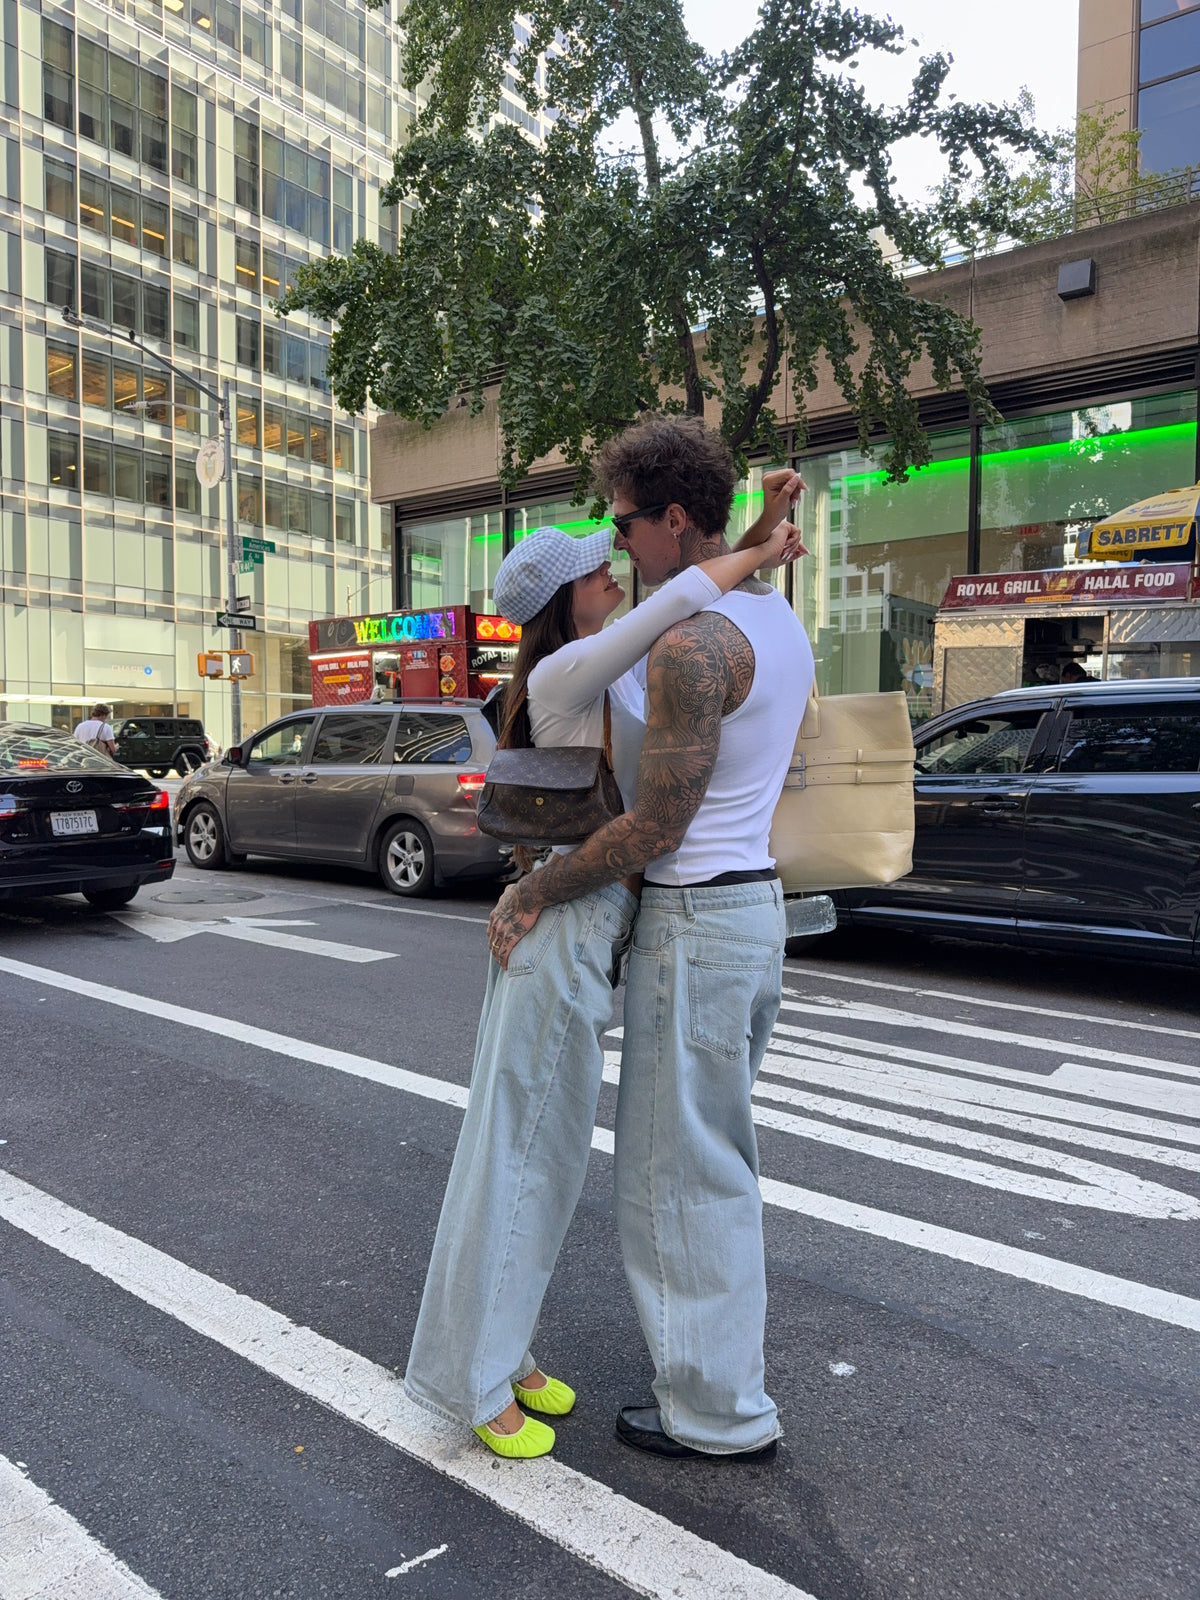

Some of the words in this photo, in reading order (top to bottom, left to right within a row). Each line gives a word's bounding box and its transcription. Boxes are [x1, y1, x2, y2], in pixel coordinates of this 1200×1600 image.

[1097, 523, 1189, 546] SABRETT
[956, 582, 1000, 597] ROYAL
[1003, 580, 1042, 594] GRILL
[1084, 574, 1130, 590] HALAL
[1134, 572, 1175, 588] FOOD
[353, 614, 445, 643] WELCOME
[471, 650, 498, 668] ROYAL
[55, 816, 94, 830] T787517C
